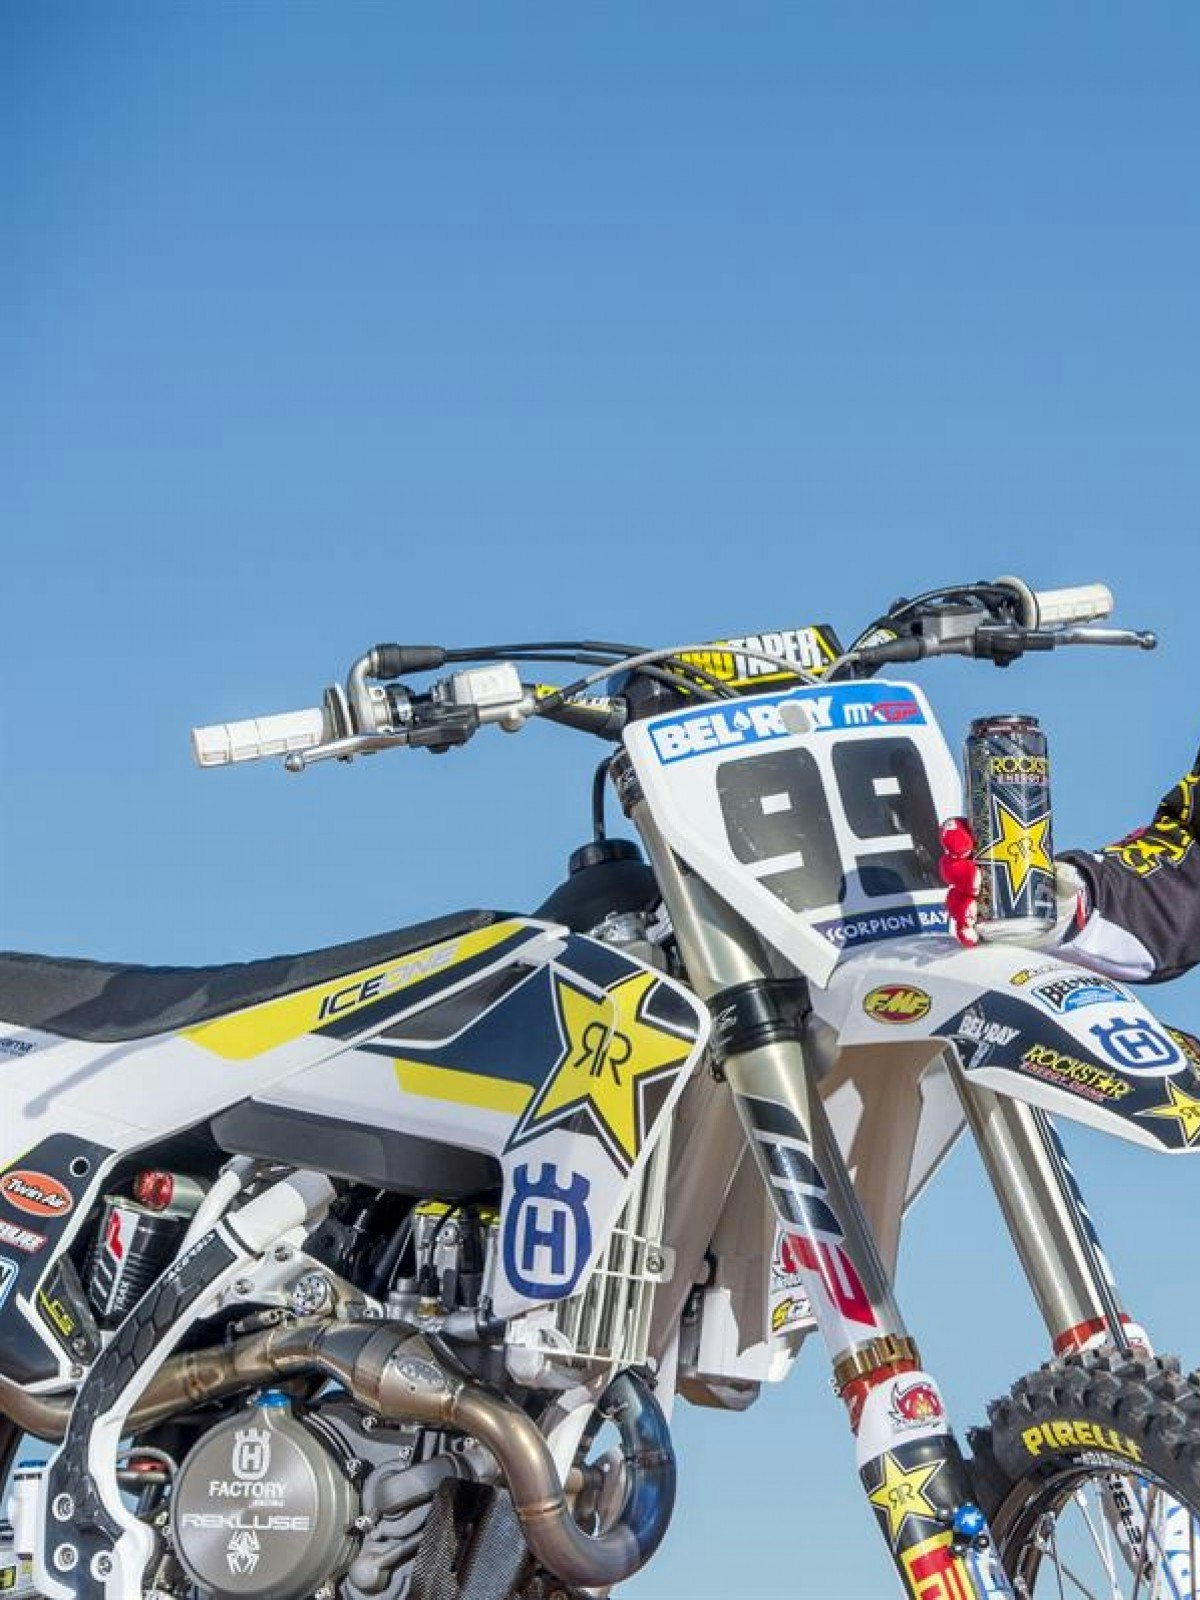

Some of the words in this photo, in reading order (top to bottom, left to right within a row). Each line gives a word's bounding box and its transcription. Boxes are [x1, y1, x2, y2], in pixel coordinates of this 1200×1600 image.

[715, 736, 956, 914] 99
[826, 914, 915, 943] SCORPION
[918, 910, 950, 926] BAY
[865, 991, 930, 1012] FMF
[208, 1481, 287, 1497] FACTORY
[182, 1513, 311, 1531] REKLUSE
